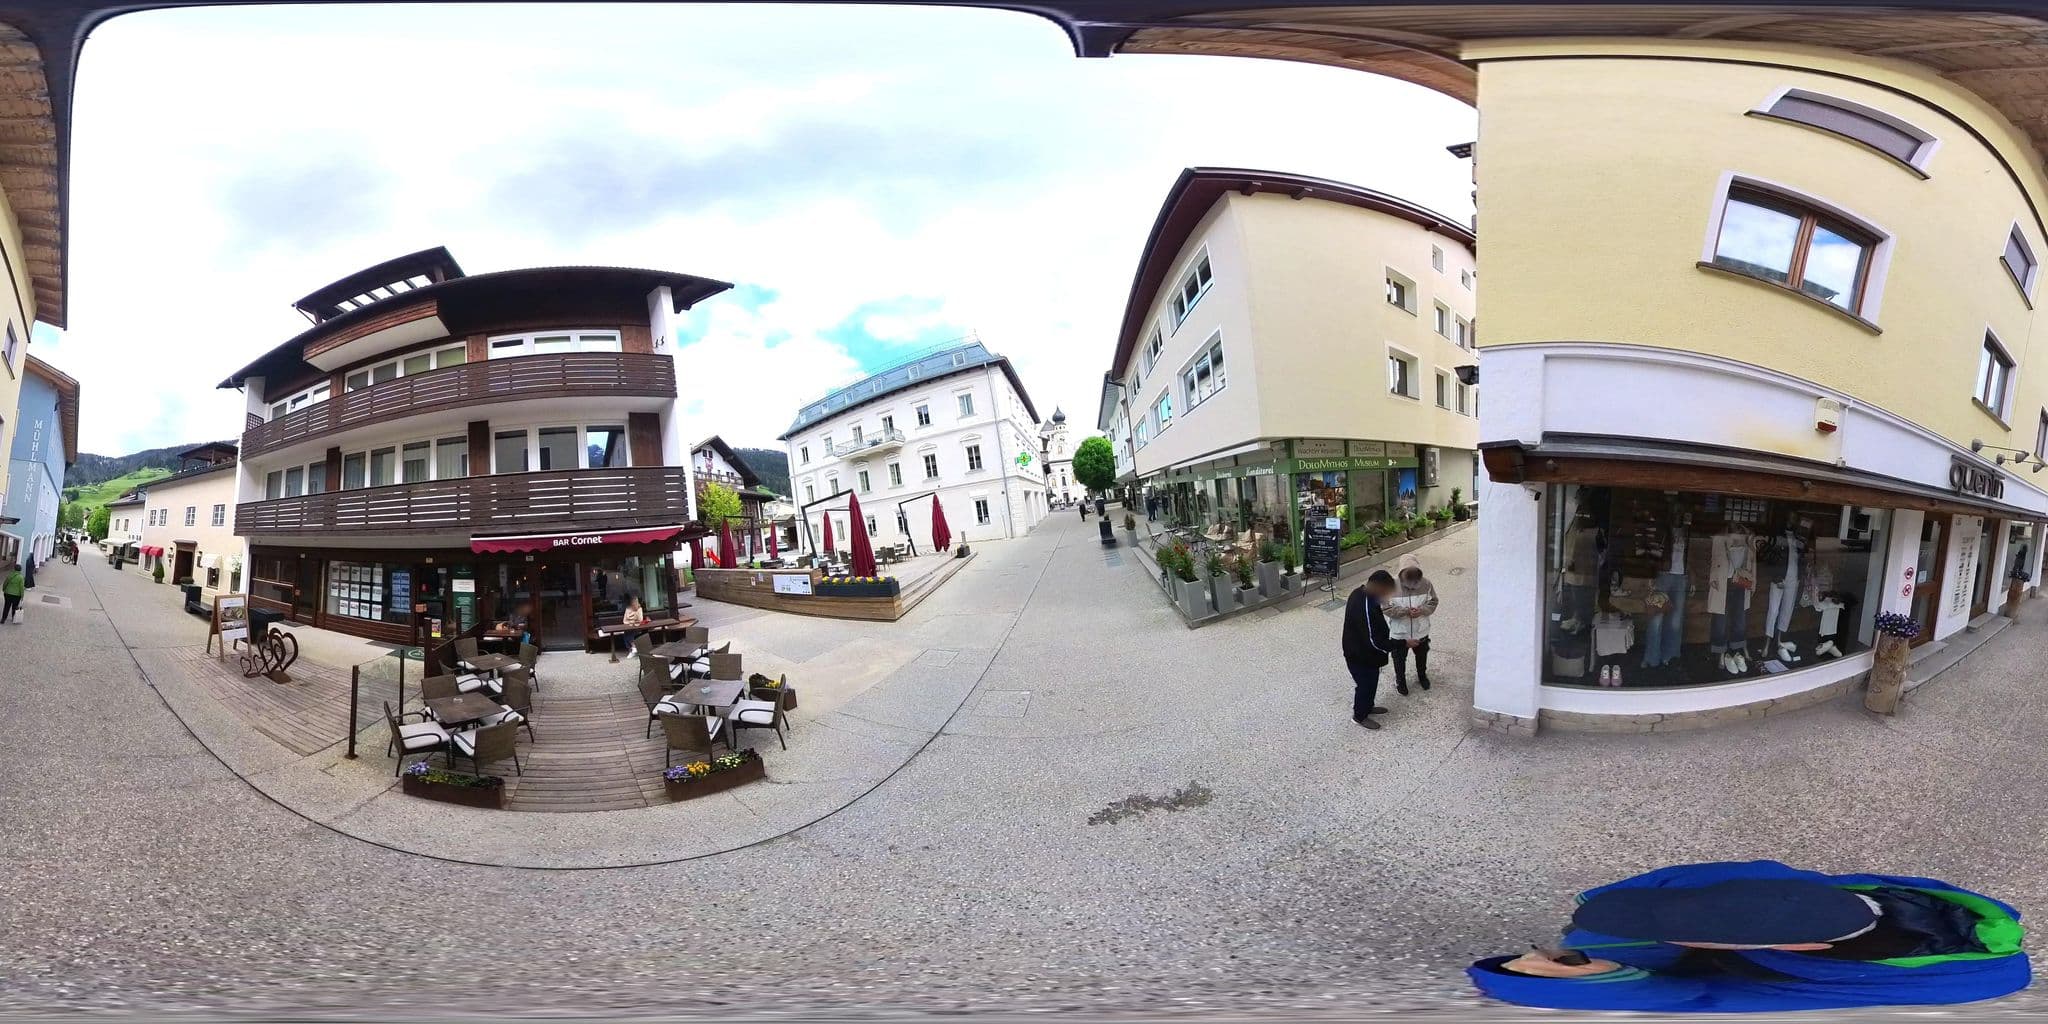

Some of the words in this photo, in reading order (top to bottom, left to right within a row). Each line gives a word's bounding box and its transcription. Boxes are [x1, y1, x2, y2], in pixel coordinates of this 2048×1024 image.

[24, 419, 43, 503] MÜHLMANN
[1949, 463, 2004, 499] quentin
[553, 539, 570, 547] BAR
[571, 535, 603, 545] Cornet
